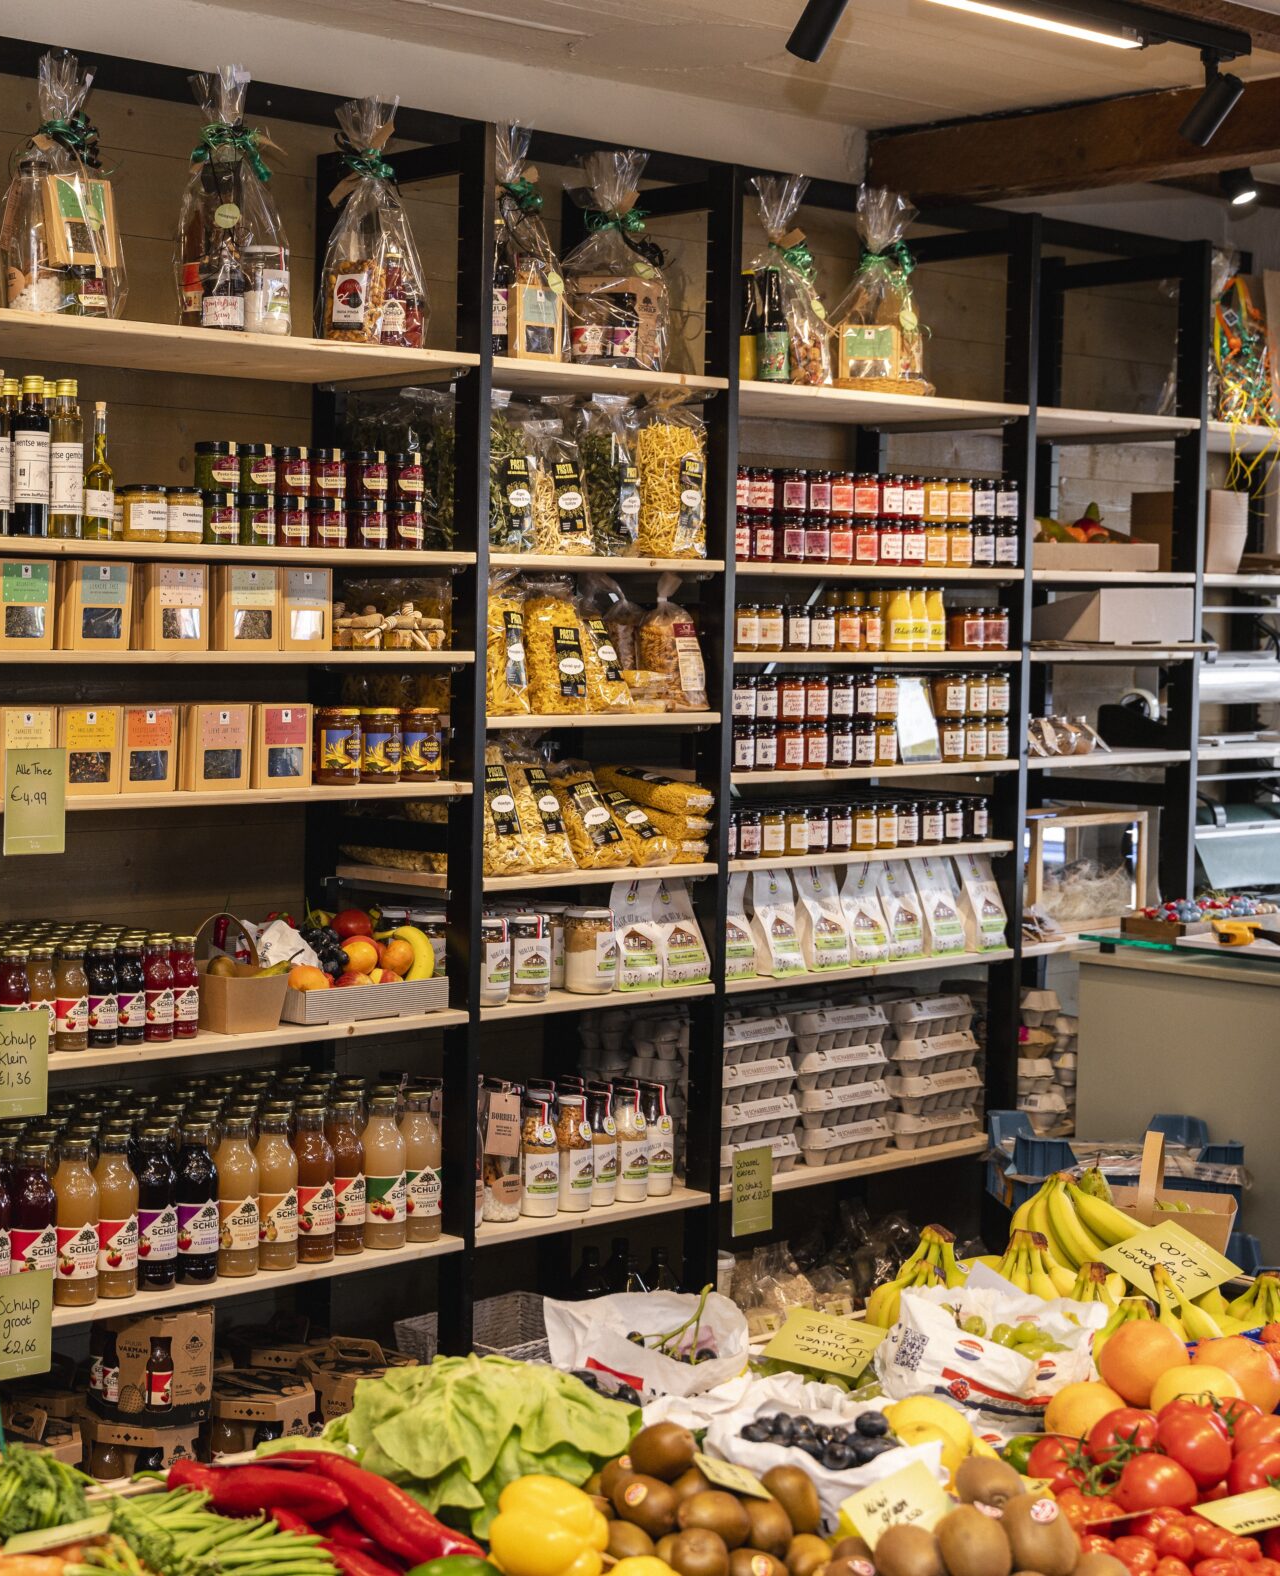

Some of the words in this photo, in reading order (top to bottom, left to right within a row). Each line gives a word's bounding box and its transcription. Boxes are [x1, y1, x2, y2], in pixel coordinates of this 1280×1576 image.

[510, 459, 525, 470] PASTA
[556, 463, 574, 474] PASTA
[685, 460, 700, 470] PASTA
[560, 629, 574, 640] PASTA
[16, 764, 31, 775] Alle
[31, 763, 52, 775] Thee
[737, 1184, 744, 1192] 10
[745, 1183, 763, 1191] stuks
[737, 1194, 751, 1203] voor
[1135, 1248, 1156, 1262] voor
[1162, 1260, 1177, 1276] kg
[1194, 1268, 1212, 1279] €
[3, 1315, 32, 1339] groot
[3, 1339, 36, 1354] €2,66
[796, 1334, 869, 1358] Druiven
[794, 1343, 857, 1368] Witte
